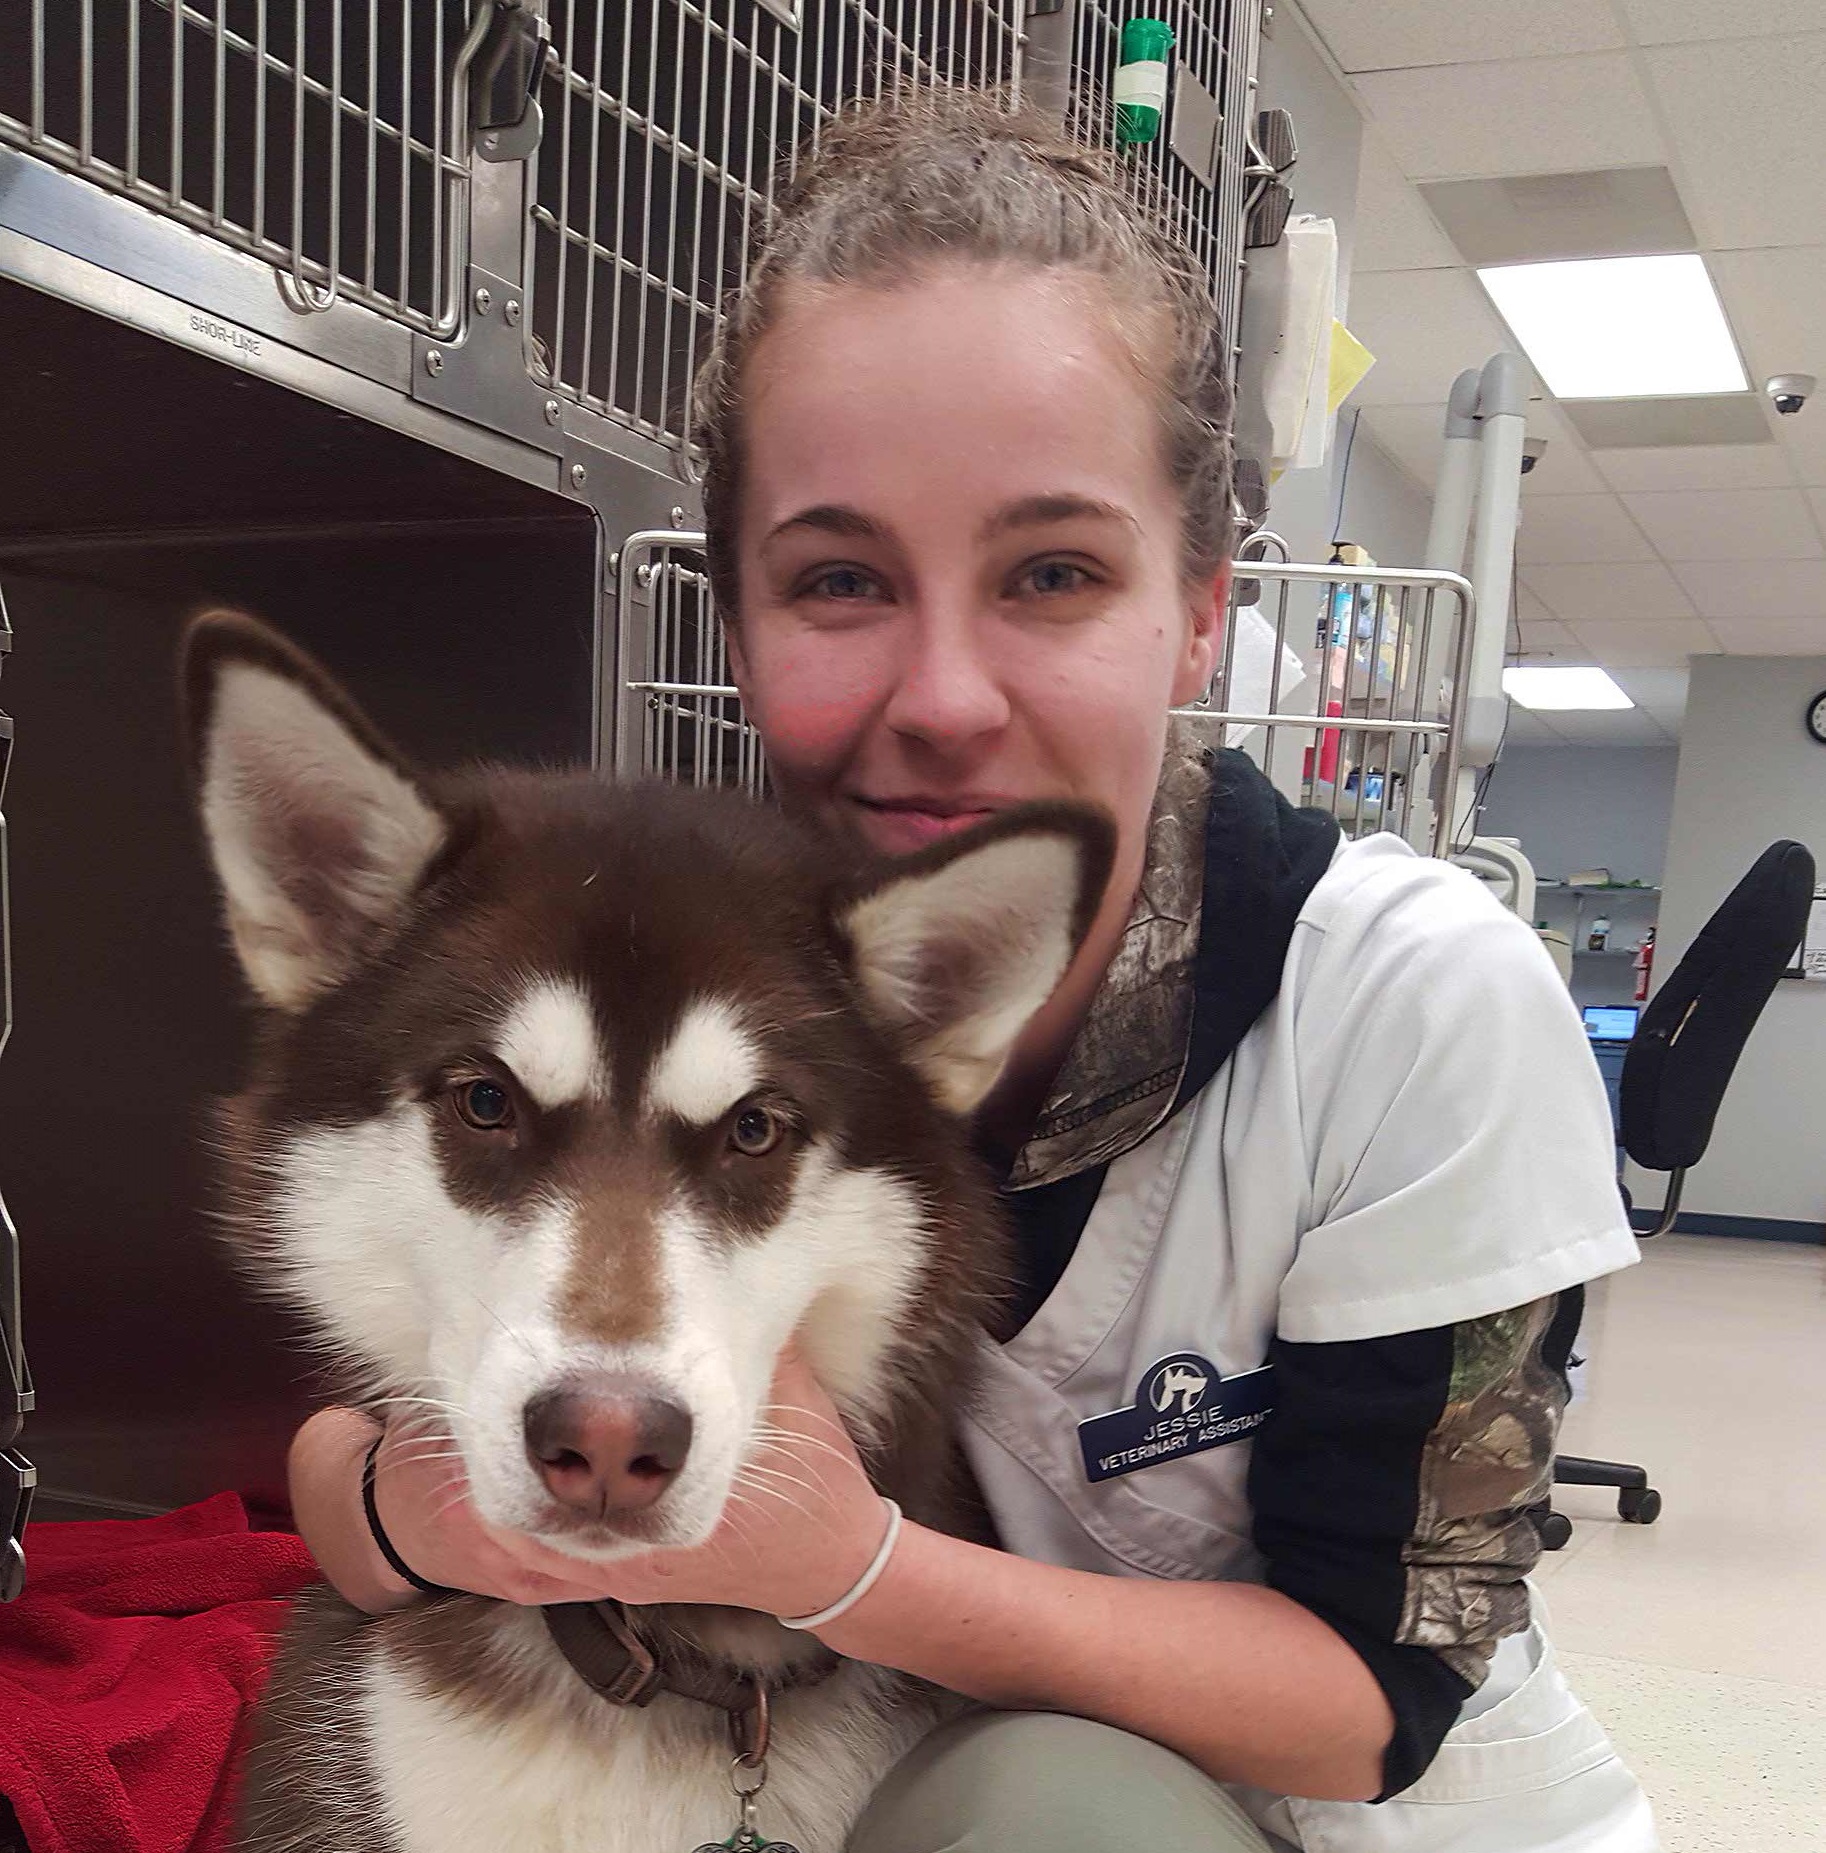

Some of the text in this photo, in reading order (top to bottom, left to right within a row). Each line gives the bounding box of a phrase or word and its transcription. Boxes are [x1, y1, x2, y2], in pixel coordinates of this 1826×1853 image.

[190, 315, 261, 356] SHOR-LINE
[1144, 1405, 1223, 1441] JESSIE
[1099, 1435, 1190, 1470] VETERINARY
